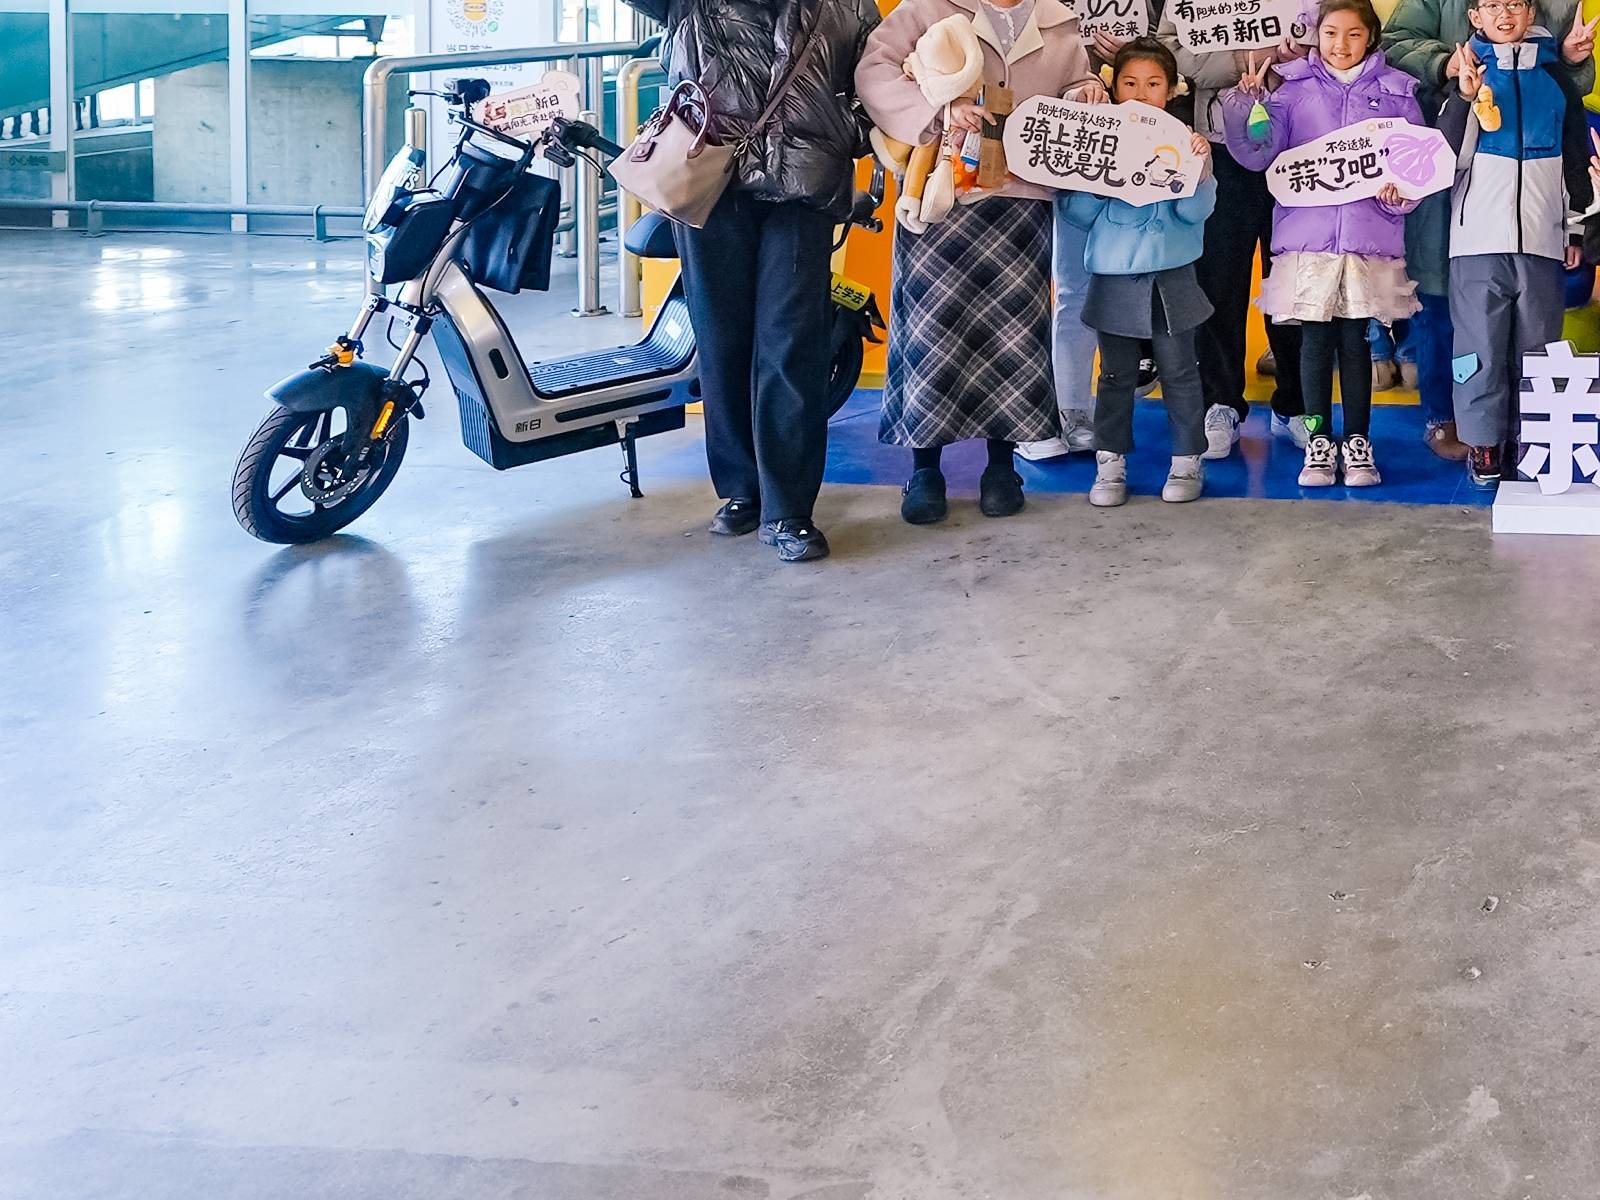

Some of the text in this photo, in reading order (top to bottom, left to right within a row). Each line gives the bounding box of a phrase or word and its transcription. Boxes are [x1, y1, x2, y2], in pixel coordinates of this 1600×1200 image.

[1078, 20, 1140, 38] 的总会来
[1188, 16, 1281, 47] 就有新日
[1036, 102, 1122, 131] 阳光何必等人给予？
[1020, 116, 1120, 156] 骑上新日
[1325, 137, 1373, 154] 不合适就
[1029, 144, 1127, 187] 我就是光
[515, 419, 541, 433] 新日
